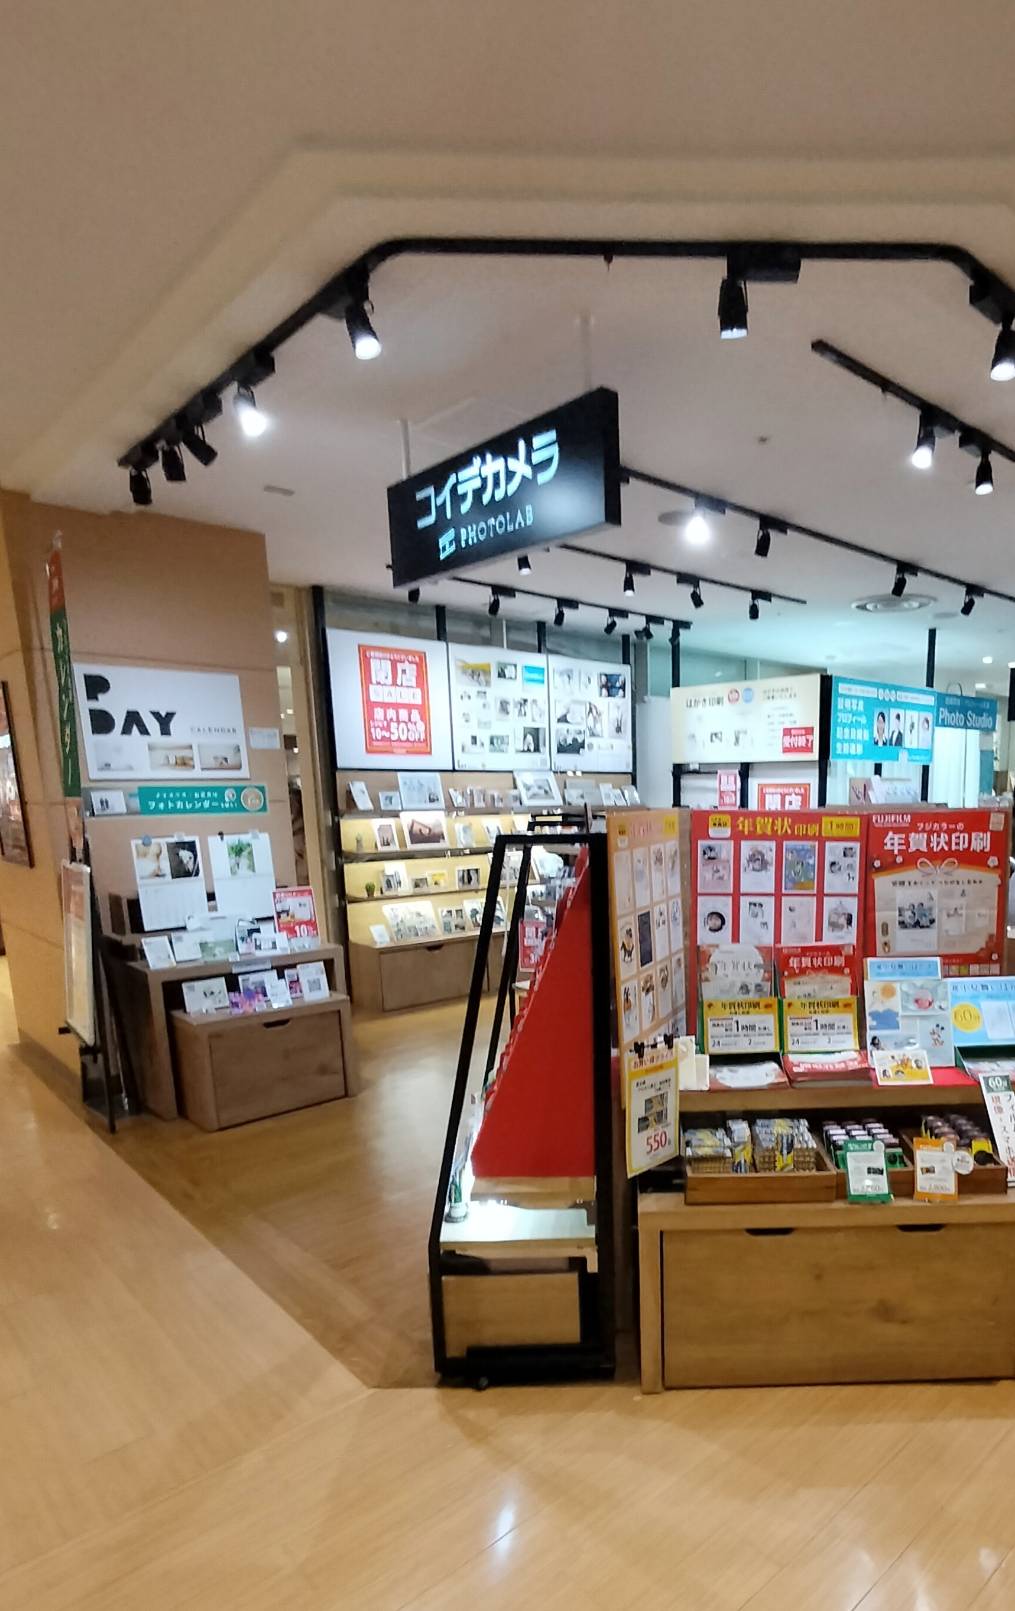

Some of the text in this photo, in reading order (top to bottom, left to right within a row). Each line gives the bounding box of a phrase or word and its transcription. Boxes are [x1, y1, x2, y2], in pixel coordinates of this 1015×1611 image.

[415, 428, 560, 530] コイデカメラ
[460, 504, 535, 549] PHOTOLAB
[88, 708, 176, 736] DAY
[938, 706, 993, 728] Photo Studio
[190, 726, 237, 735] CALENDAR
[872, 813, 911, 824] FUJIFILM
[917, 822, 965, 831] フジカラーの
[884, 831, 992, 855] 年賀状印刷
[789, 955, 845, 971] 年賀状印刷
